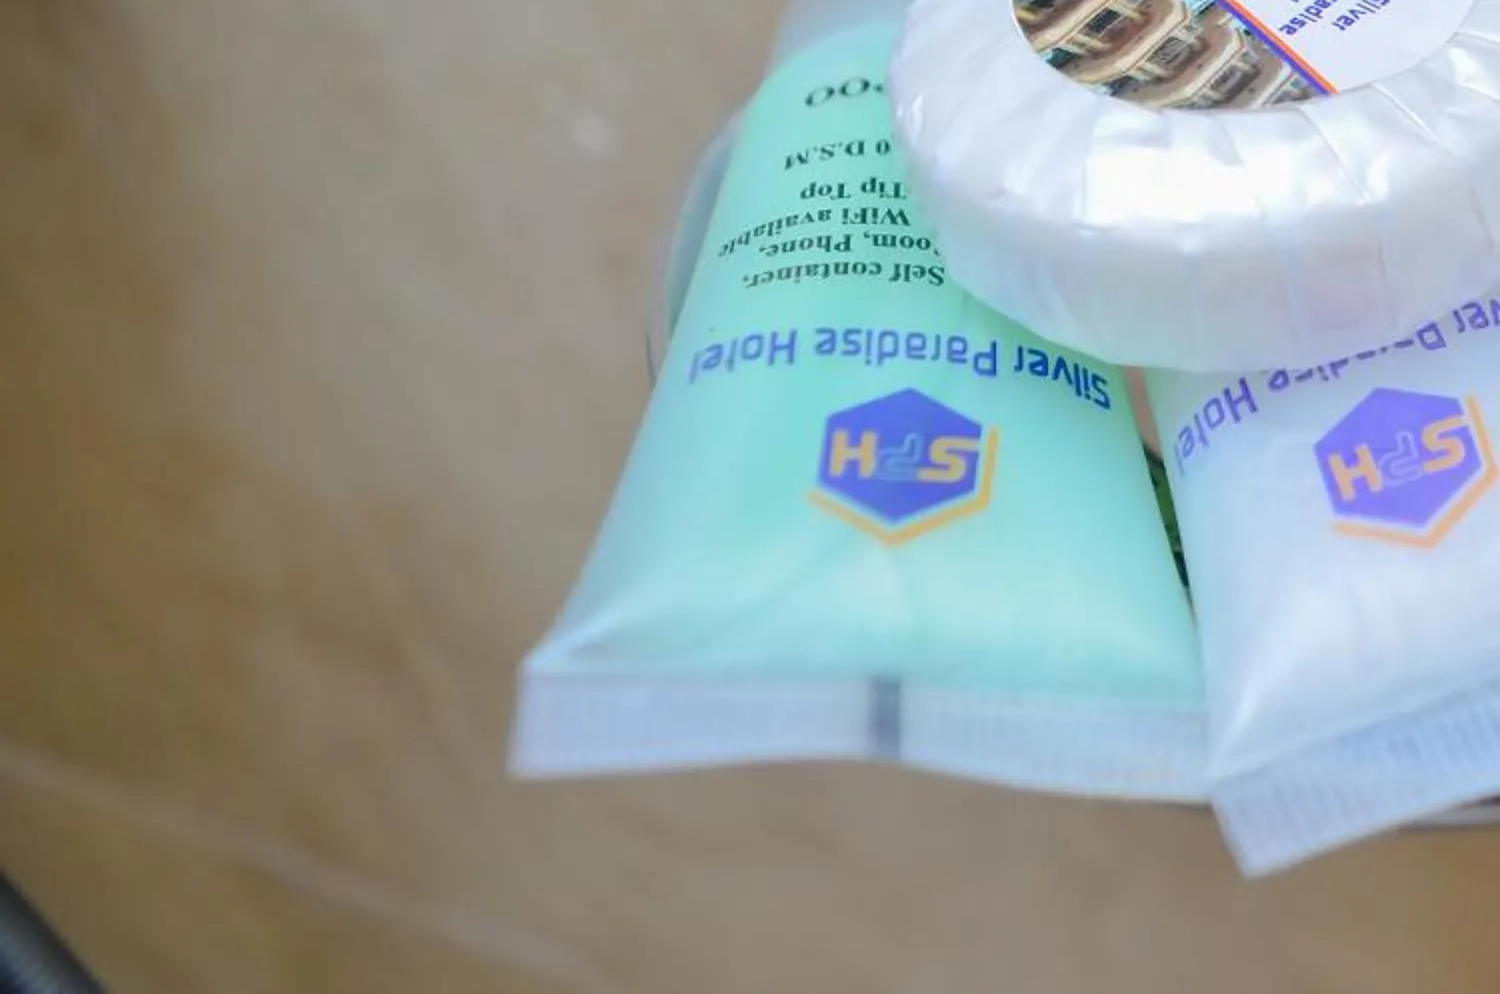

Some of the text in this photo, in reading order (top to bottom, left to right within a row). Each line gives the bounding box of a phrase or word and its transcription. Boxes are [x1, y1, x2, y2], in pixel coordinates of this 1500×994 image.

[800, 177, 907, 201] Tip Top
[841, 207, 911, 226] WiFi
[863, 230, 941, 256] oom,
[889, 263, 946, 287] Self
[689, 327, 1111, 409] Silver Paradise Hotel
[1175, 378, 1258, 476] Hotel
[829, 429, 980, 483] SPH
[1328, 414, 1469, 501] SPH
